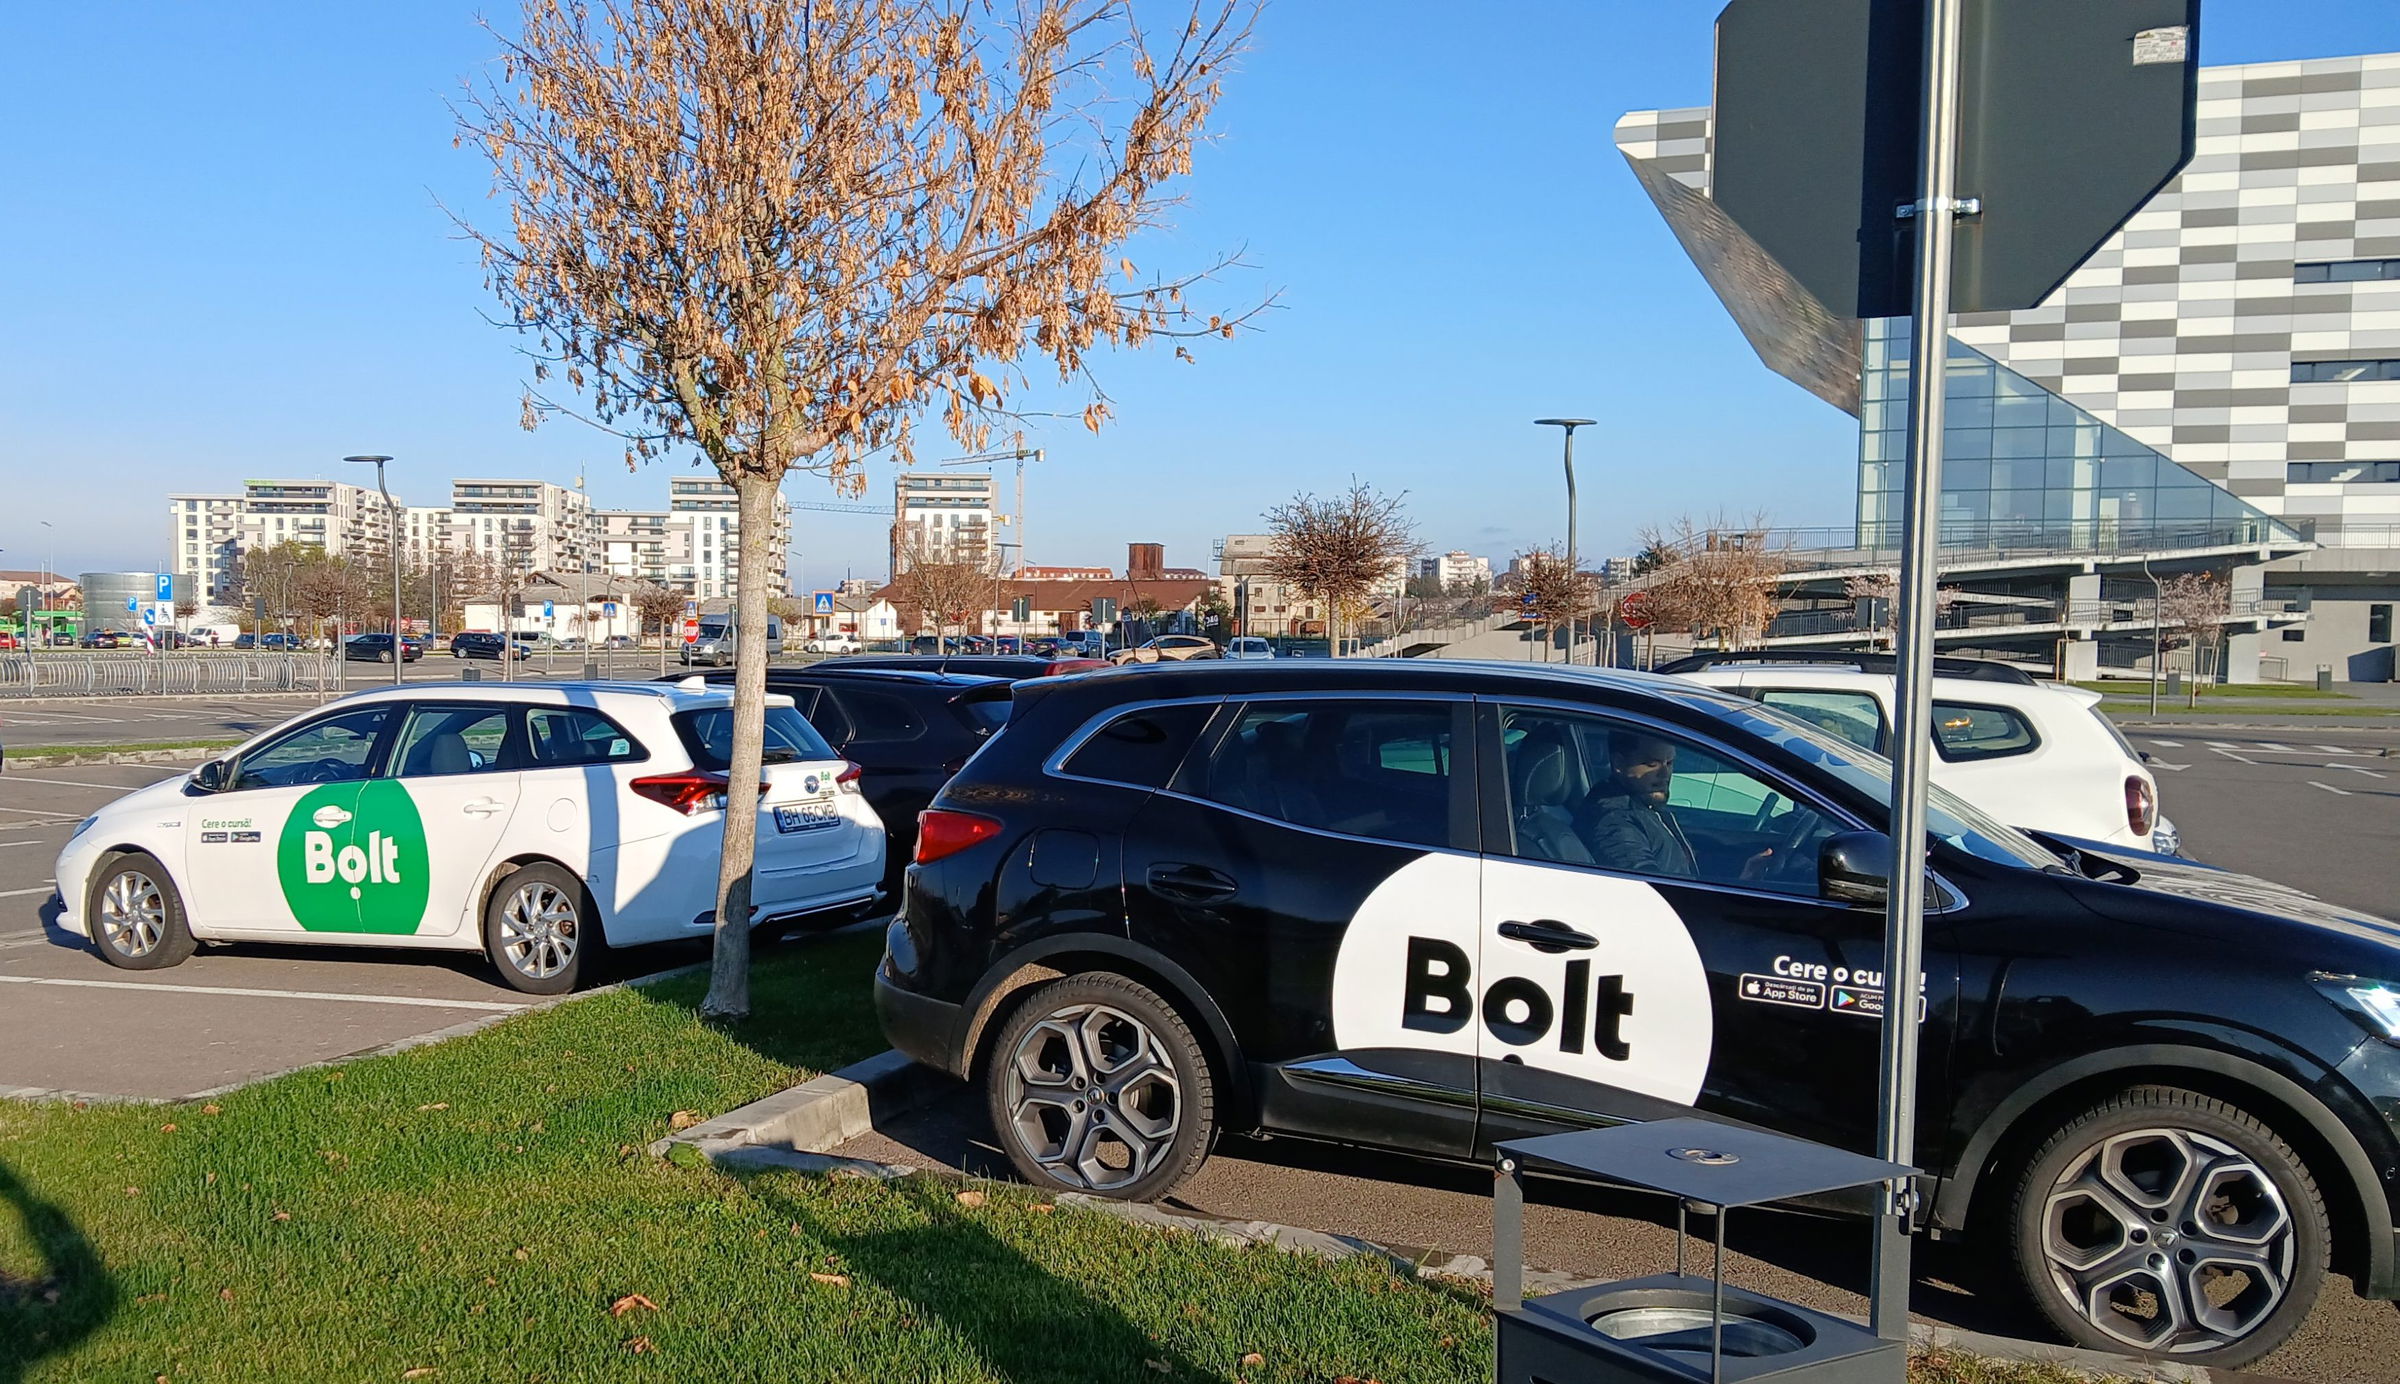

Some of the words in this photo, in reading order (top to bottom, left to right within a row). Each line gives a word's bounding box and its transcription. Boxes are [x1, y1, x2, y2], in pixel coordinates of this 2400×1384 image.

[159, 576, 169, 593] P
[201, 818, 220, 829] Cere
[221, 820, 227, 828] o
[782, 808, 801, 826] BH
[305, 830, 400, 884] Bolt
[1773, 955, 1828, 981] Cere
[1833, 966, 1849, 982] o
[1401, 935, 1635, 1061] Bolt
[1763, 987, 1786, 999] App
[1787, 990, 1817, 1003] Store
